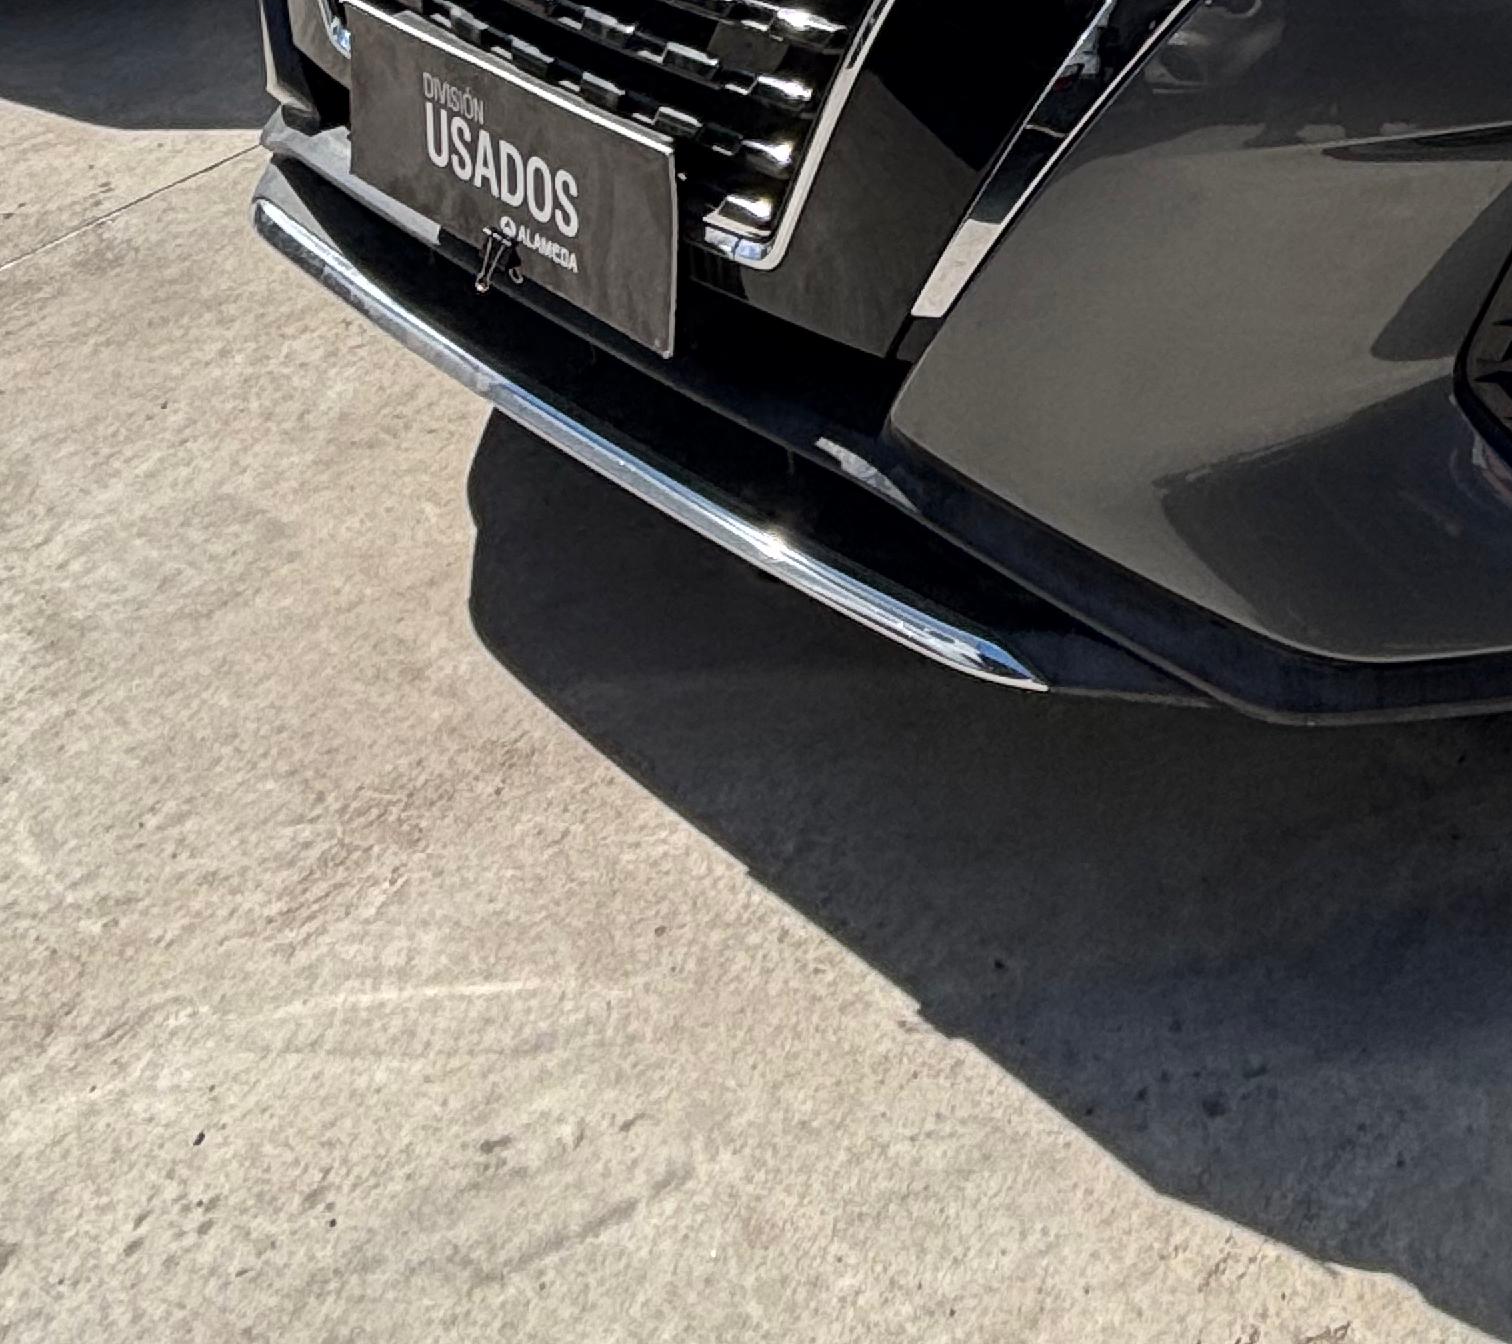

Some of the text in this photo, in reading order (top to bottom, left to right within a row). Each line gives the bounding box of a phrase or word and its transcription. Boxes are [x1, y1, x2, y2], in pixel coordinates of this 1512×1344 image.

[422, 72, 484, 125] DIVISIÓN
[425, 102, 578, 238] USADOS
[517, 224, 579, 273] ALAMEDA
